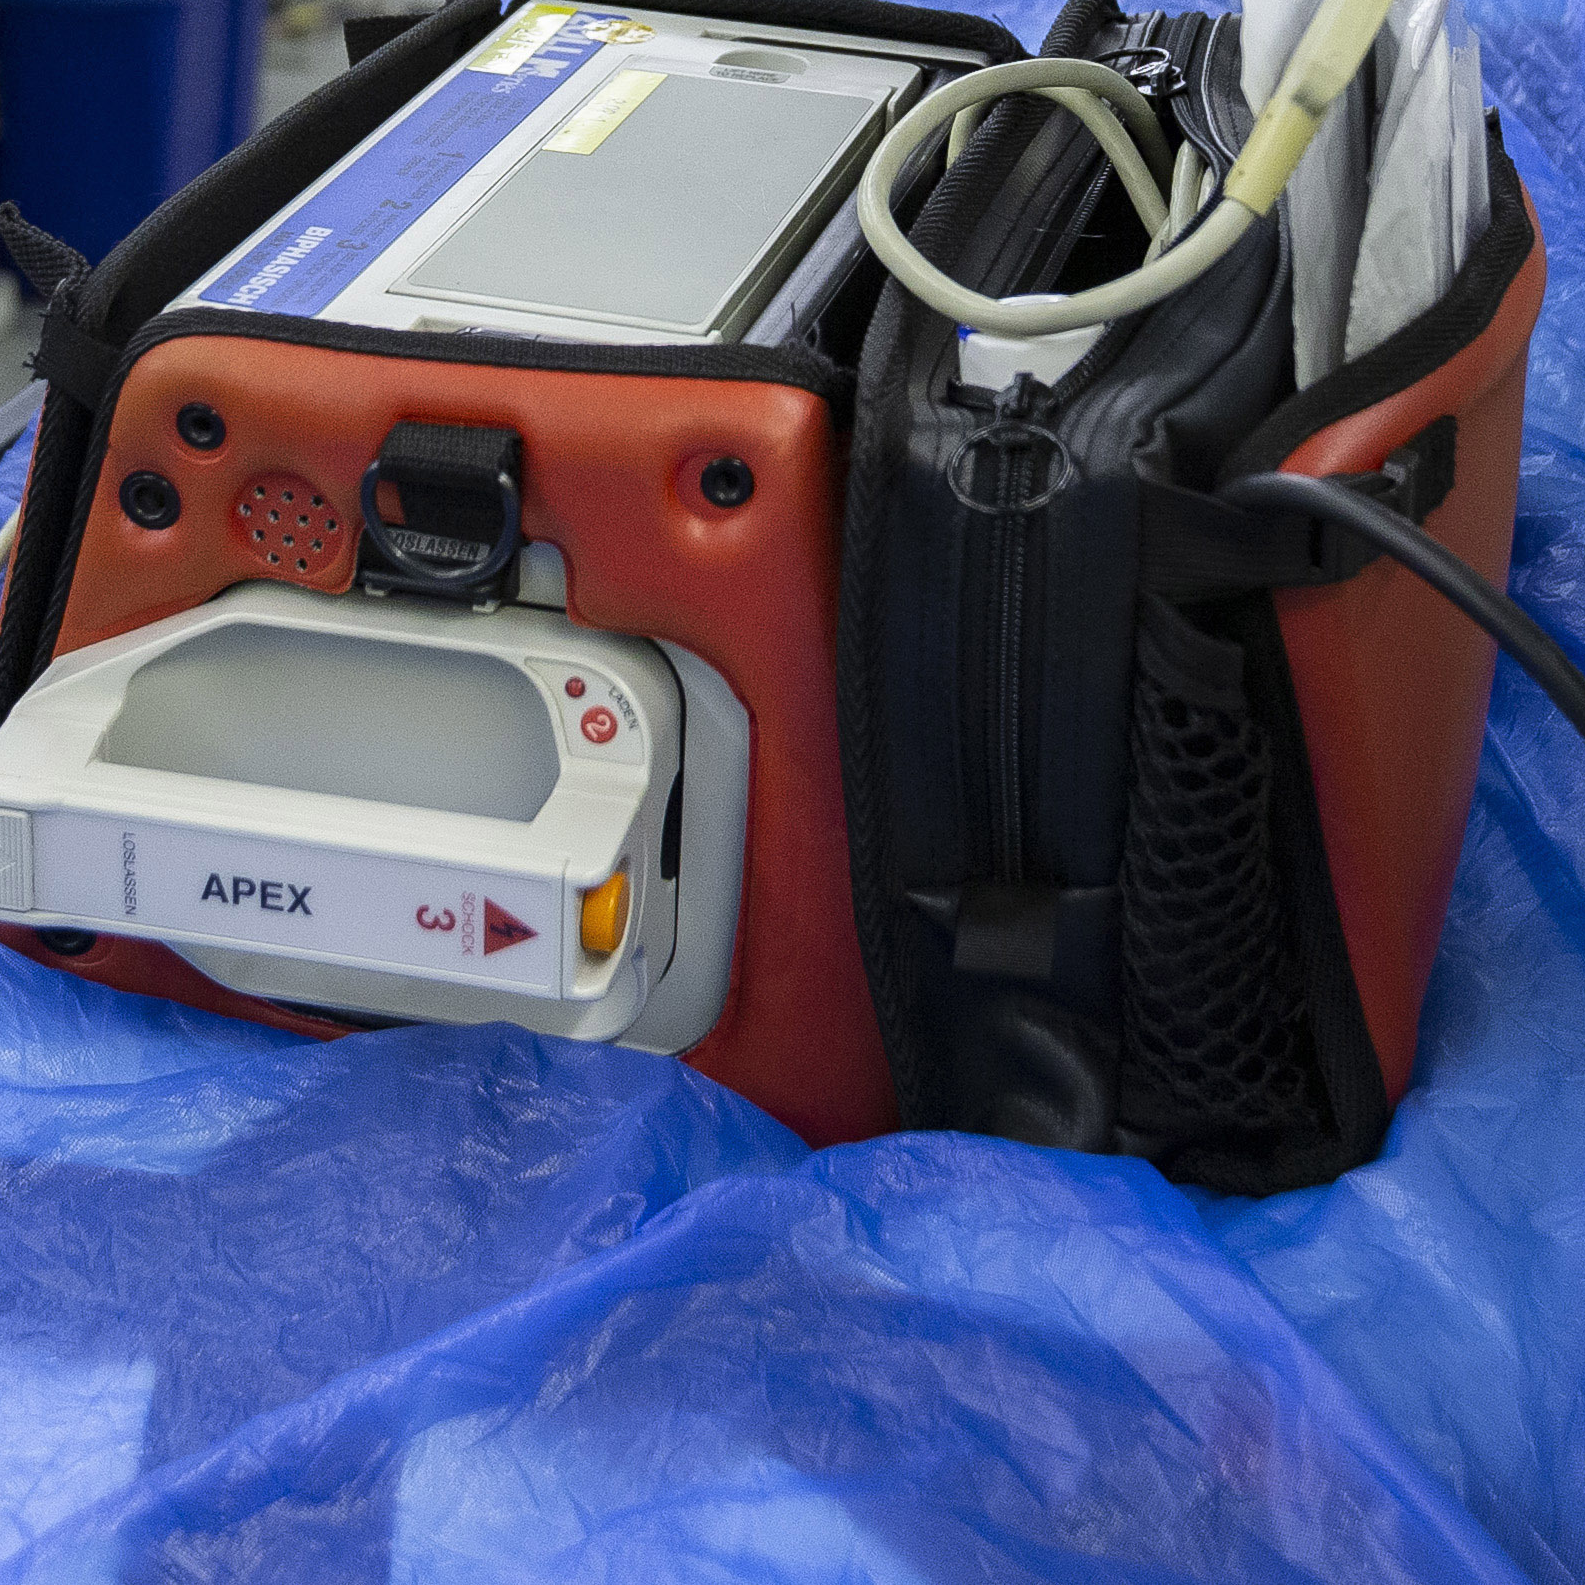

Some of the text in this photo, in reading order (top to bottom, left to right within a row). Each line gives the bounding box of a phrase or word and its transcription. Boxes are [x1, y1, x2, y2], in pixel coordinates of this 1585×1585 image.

[379, 198, 413, 211] 2
[336, 238, 369, 251] 3
[227, 226, 334, 305] BIPHASISCH
[584, 713, 611, 740] 2
[122, 831, 137, 915] LOSLASSEN
[201, 872, 313, 916] APEX
[416, 904, 456, 932] 3
[461, 892, 476, 955] SCHOCK
